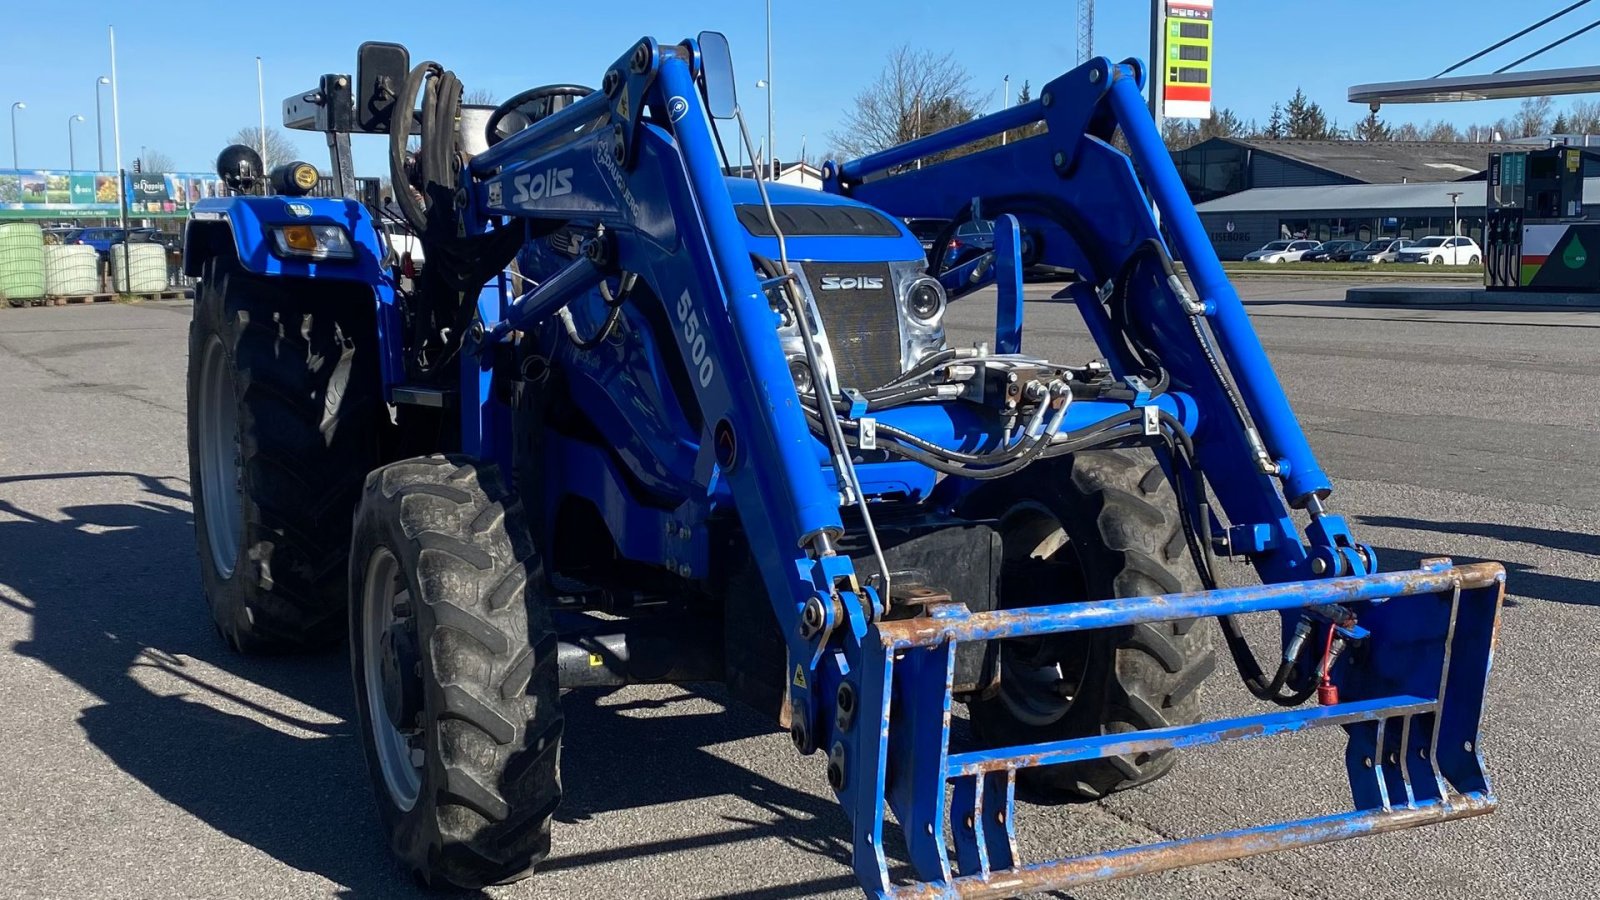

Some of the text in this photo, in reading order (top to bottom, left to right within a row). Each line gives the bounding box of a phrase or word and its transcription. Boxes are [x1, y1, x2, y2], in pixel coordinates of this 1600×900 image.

[512, 167, 574, 204] SOLIS
[821, 276, 884, 290] SOLIS
[676, 288, 714, 388] 5500
